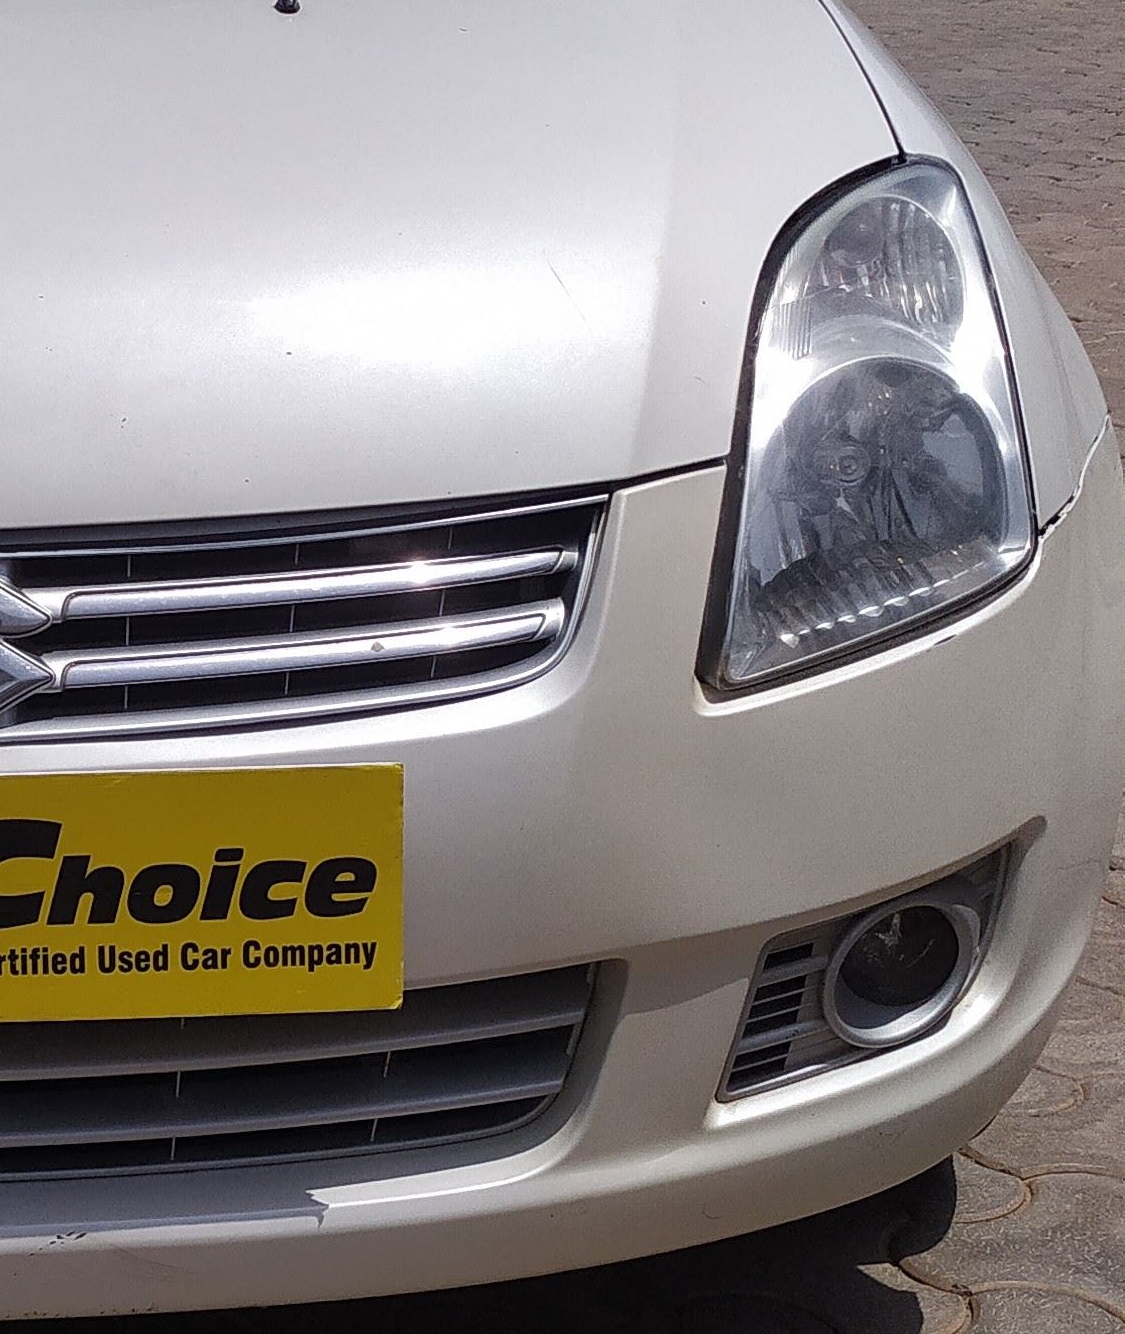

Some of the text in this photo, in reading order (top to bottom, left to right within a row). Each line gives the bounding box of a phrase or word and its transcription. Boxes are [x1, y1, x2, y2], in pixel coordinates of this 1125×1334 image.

[97, 944, 169, 974] Used
[180, 941, 232, 971] Car
[242, 939, 377, 972] Company
